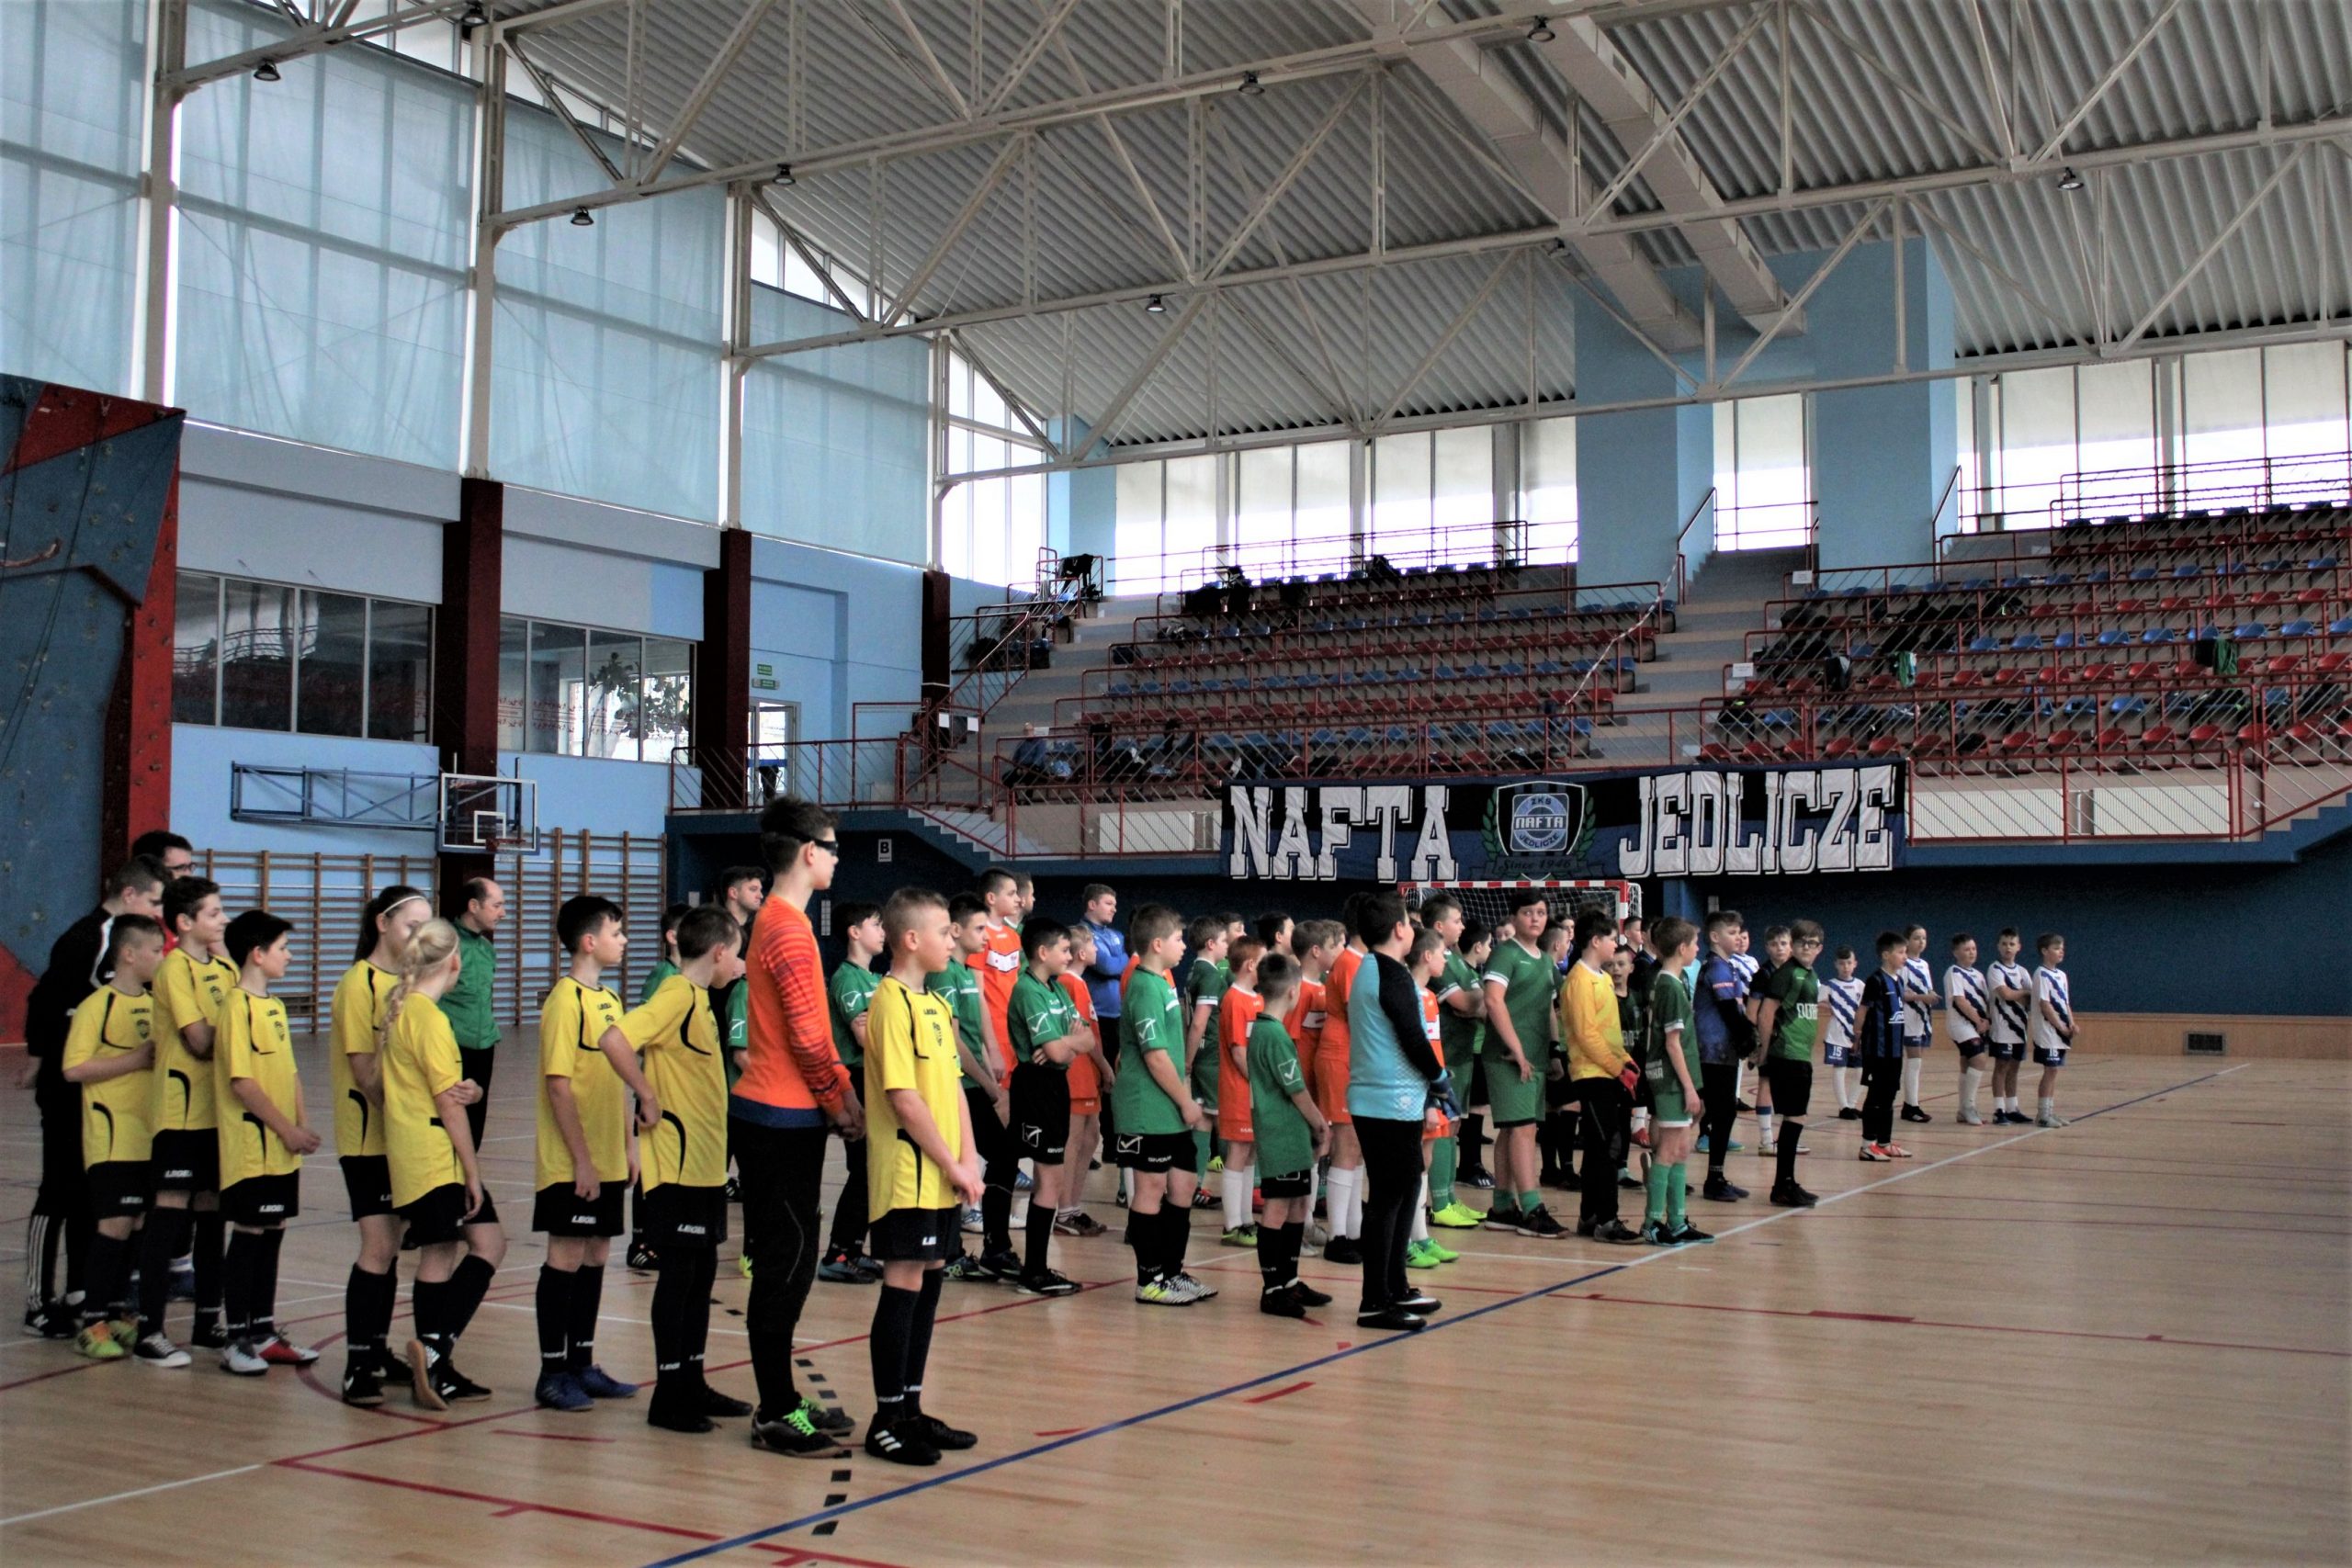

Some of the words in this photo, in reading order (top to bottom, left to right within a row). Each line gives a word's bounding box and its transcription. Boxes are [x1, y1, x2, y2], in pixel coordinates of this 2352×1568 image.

[1531, 797, 1552, 806] ZKS
[1229, 784, 1459, 884] NAFTA
[1618, 763, 1896, 879] JEDLICZE
[1515, 816, 1564, 829] NAFTA
[1519, 832, 1560, 849] JEDLICZE
[880, 841, 889, 853] B
[1833, 1045, 1842, 1056] 15
[2049, 1049, 2059, 1057] 16
